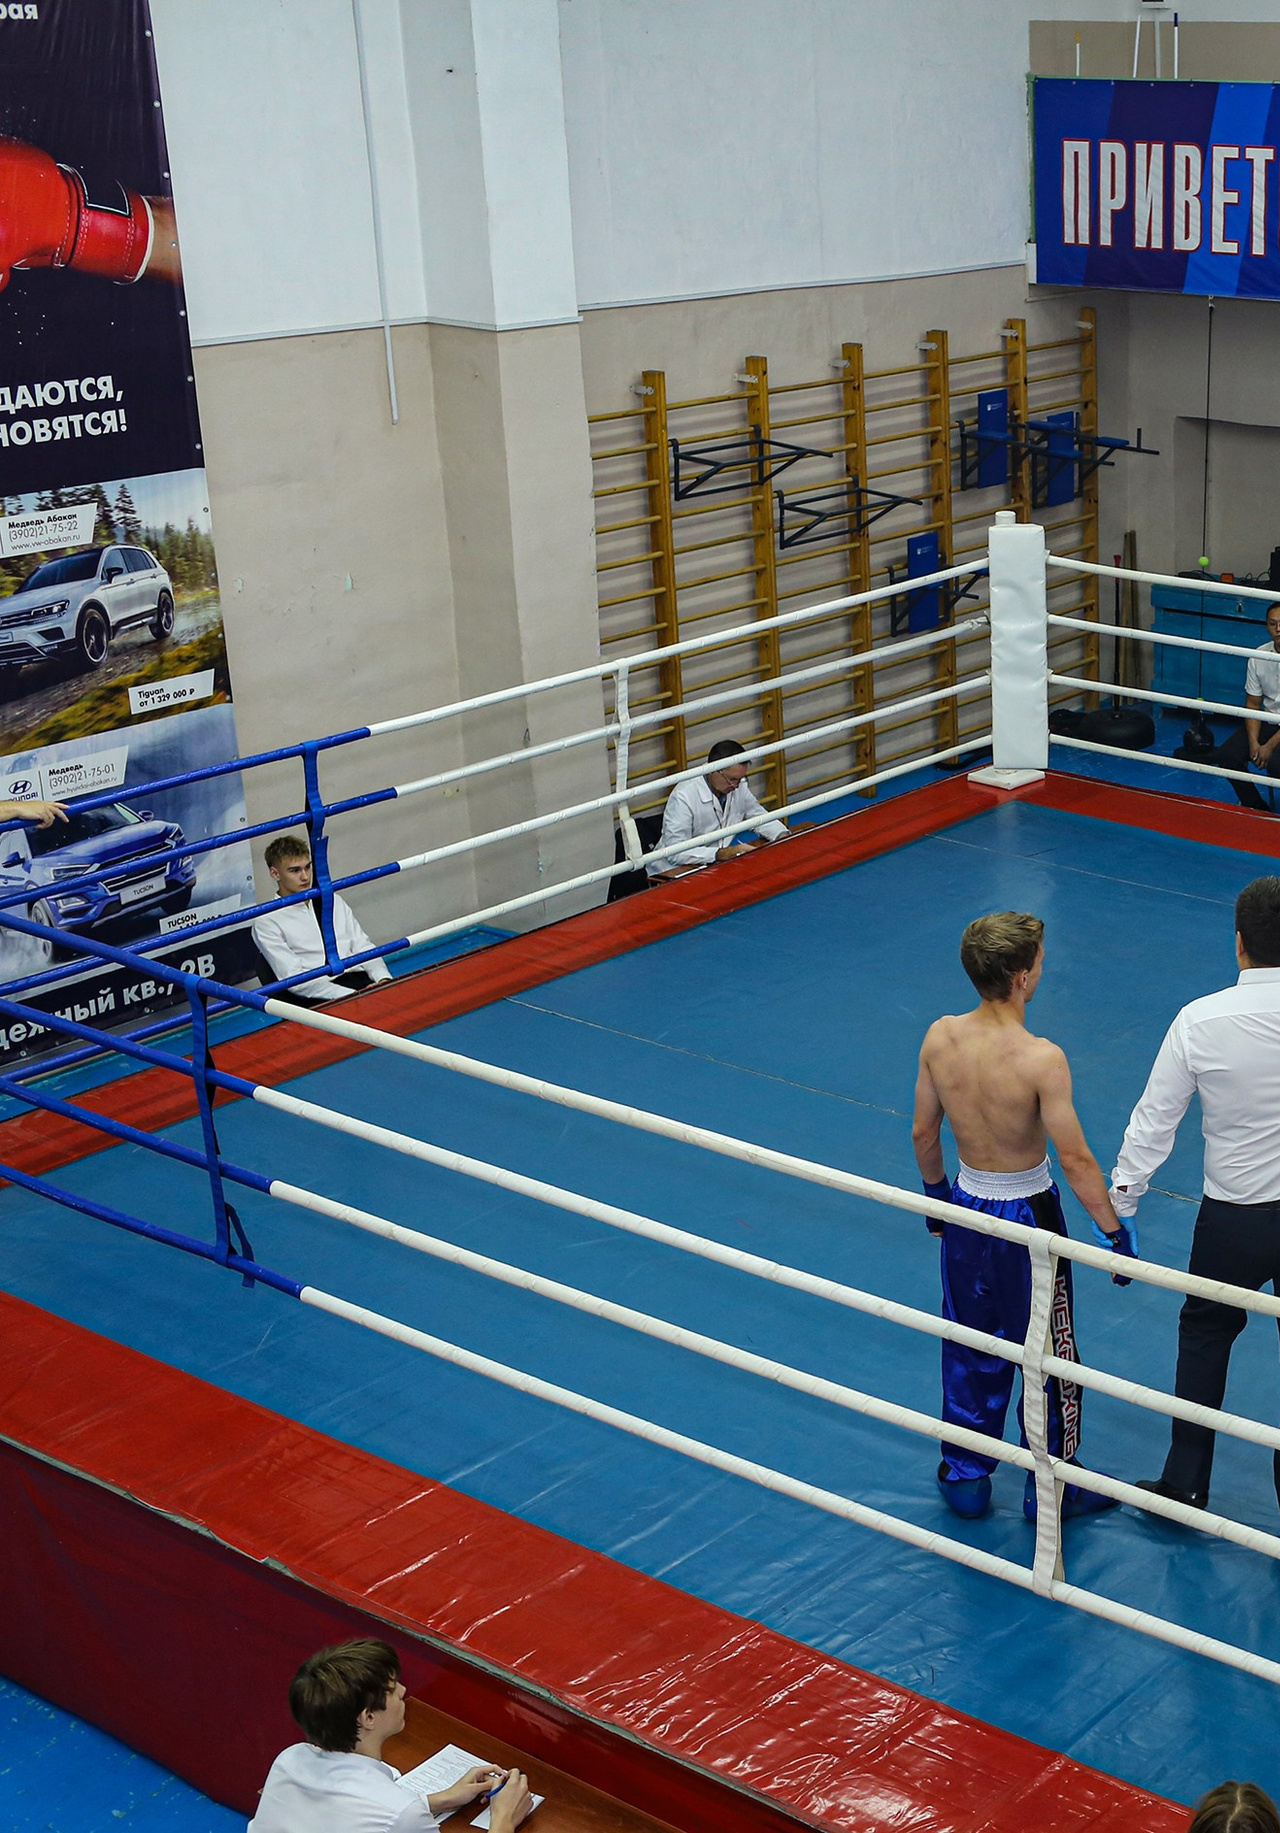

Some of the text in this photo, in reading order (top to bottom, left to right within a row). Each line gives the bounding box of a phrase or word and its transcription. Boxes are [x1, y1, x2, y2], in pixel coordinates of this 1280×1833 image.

[0, 375, 124, 415] ДАЮТСЯ,
[138, 687, 165, 699] Tiguan
[48, 763, 84, 777] Медведь
[49, 763, 116, 790] (3902)21-75-01
[9, 791, 39, 802] YUNDAI
[167, 912, 198, 929] TUCSON
